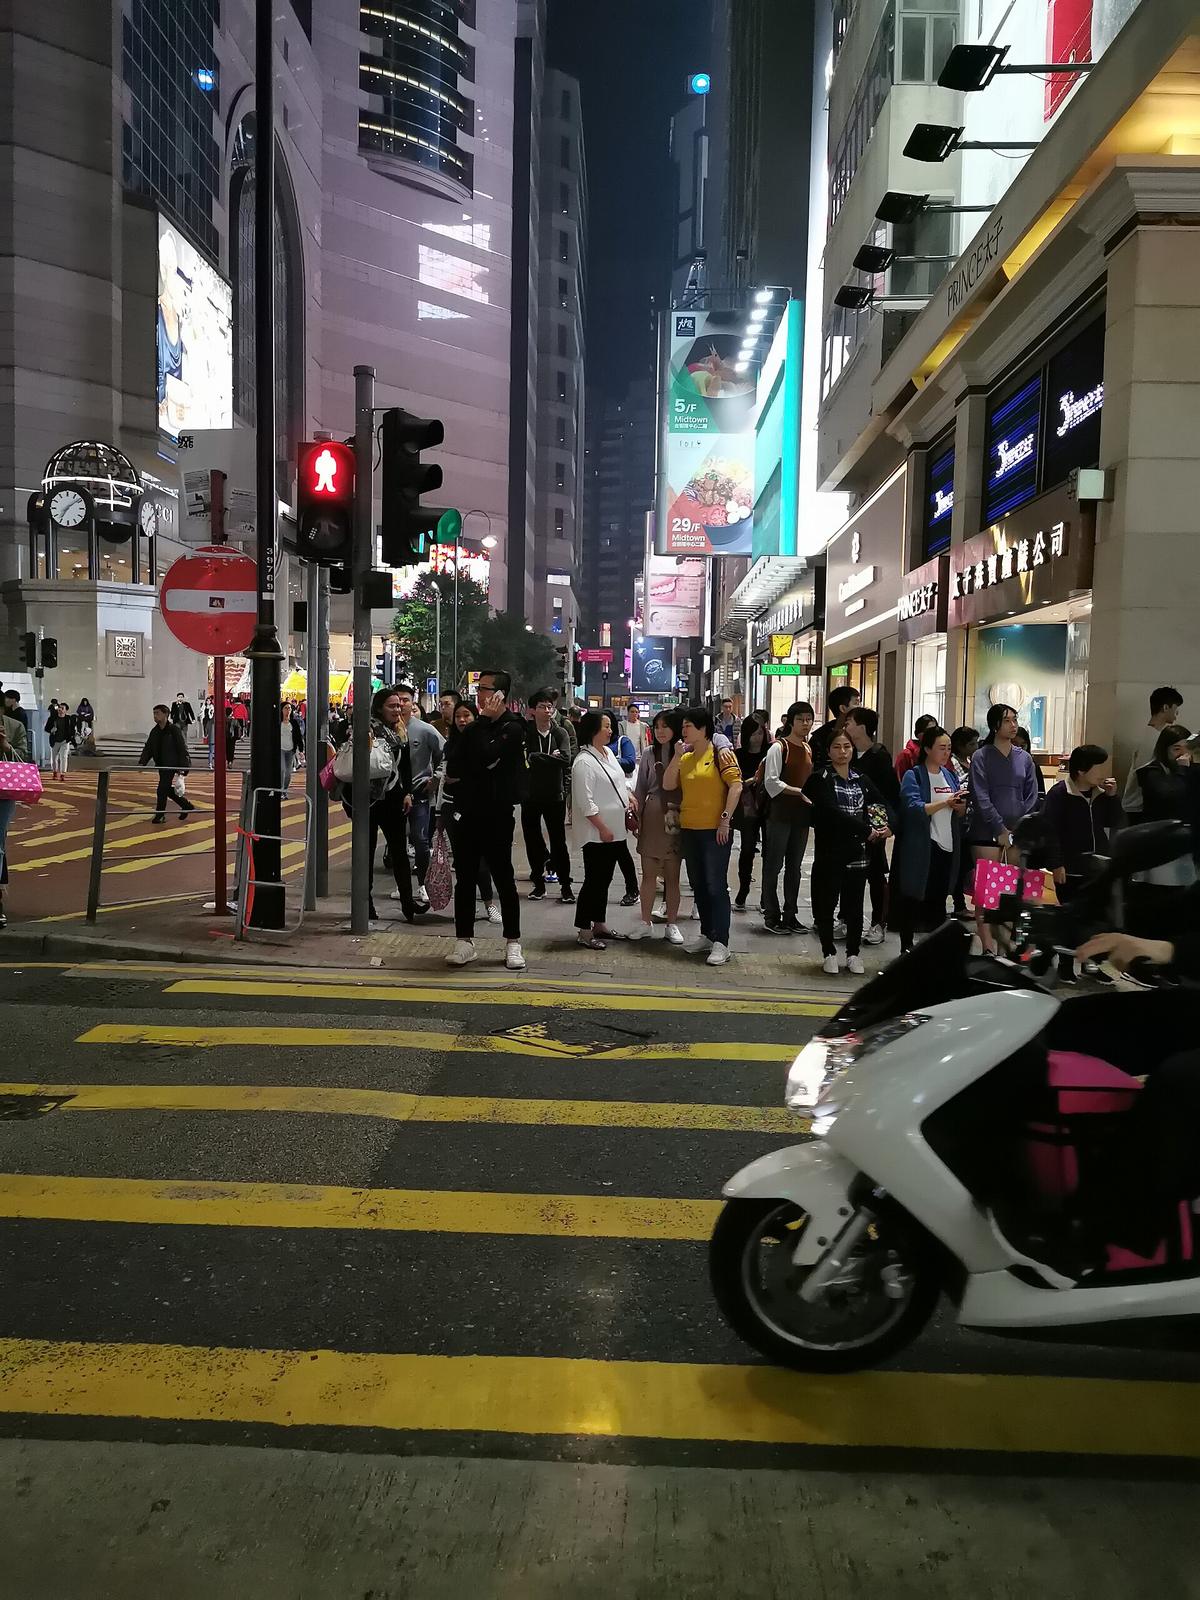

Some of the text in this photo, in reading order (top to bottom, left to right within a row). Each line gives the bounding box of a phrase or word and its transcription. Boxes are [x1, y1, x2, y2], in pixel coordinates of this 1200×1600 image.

[674, 398, 697, 414] 5/F
[674, 415, 708, 423] Midtown
[672, 517, 701, 533] 29/F
[672, 533, 706, 542] Midtown
